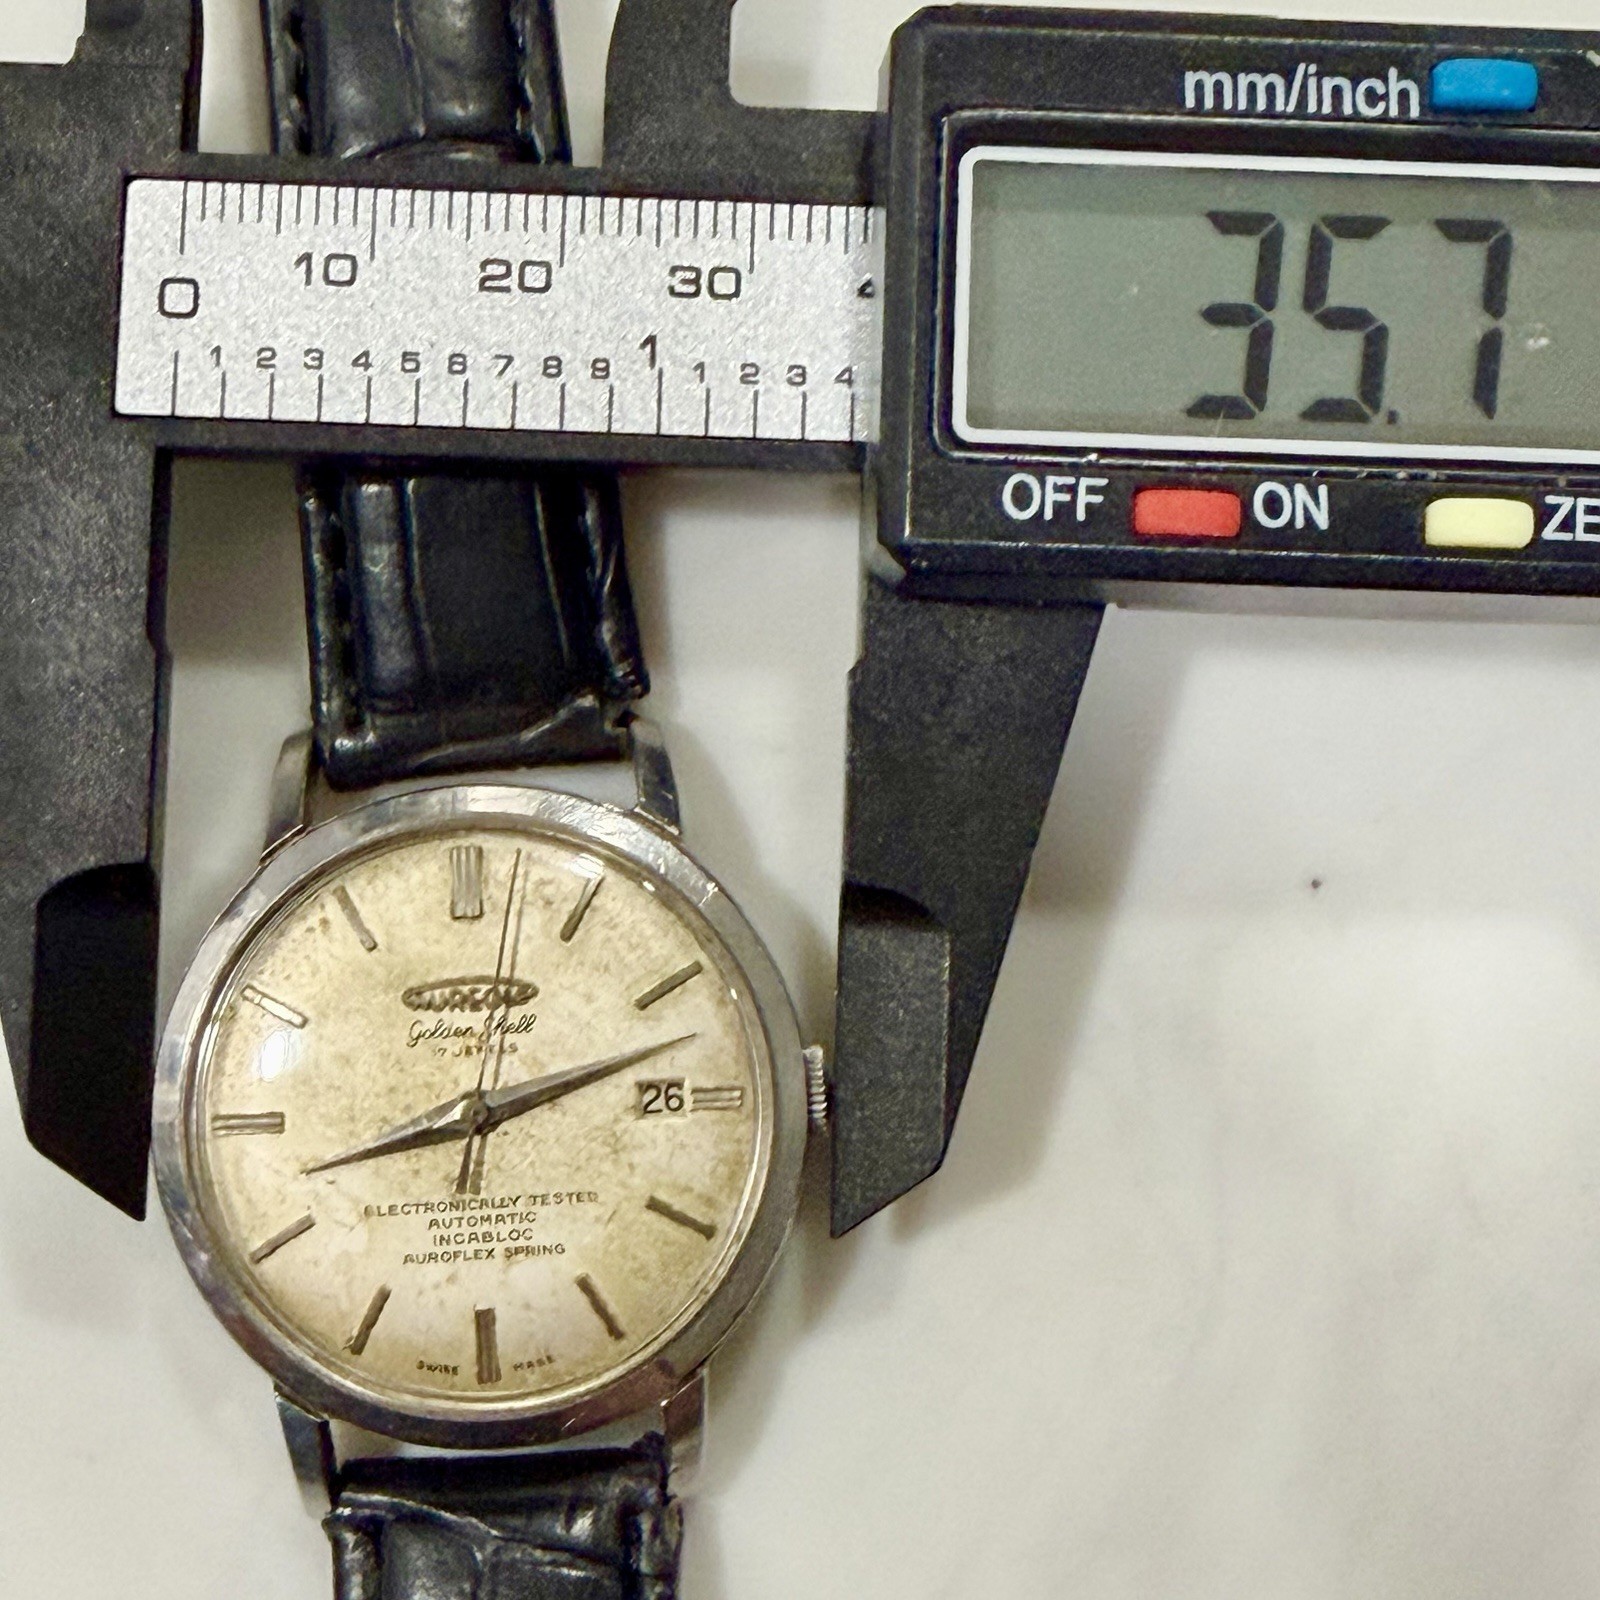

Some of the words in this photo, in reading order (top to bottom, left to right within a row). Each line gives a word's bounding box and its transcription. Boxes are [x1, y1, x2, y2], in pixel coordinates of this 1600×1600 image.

[1184, 63, 1420, 118] mm/inch
[156, 276, 201, 319] 0
[294, 252, 358, 287] 10
[478, 258, 552, 294] 20
[667, 265, 742, 301] 30
[1186, 210, 1512, 424] 35.7
[210, 345, 222, 368] 1
[256, 347, 278, 370] 2
[303, 348, 325, 370] 3
[351, 349, 374, 372] 4
[400, 351, 421, 374] 5
[493, 354, 515, 378] 7
[541, 355, 563, 379] 8
[639, 333, 658, 371] 1
[692, 361, 706, 384] 1
[740, 363, 760, 386] 2
[786, 364, 807, 387] 3
[834, 366, 855, 389] 4
[1001, 473, 1109, 521] OFF
[1253, 481, 1330, 531] ON
[406, 1018, 474, 1047] Golden
[643, 1083, 685, 1114] 26
[363, 1194, 521, 1217] ELECTRONICALLY
[428, 1211, 537, 1230] AUTOMATIC
[433, 1228, 533, 1247] INCABLOC
[402, 1247, 496, 1265] AUROFLEX
[504, 1243, 566, 1259] SPRING
